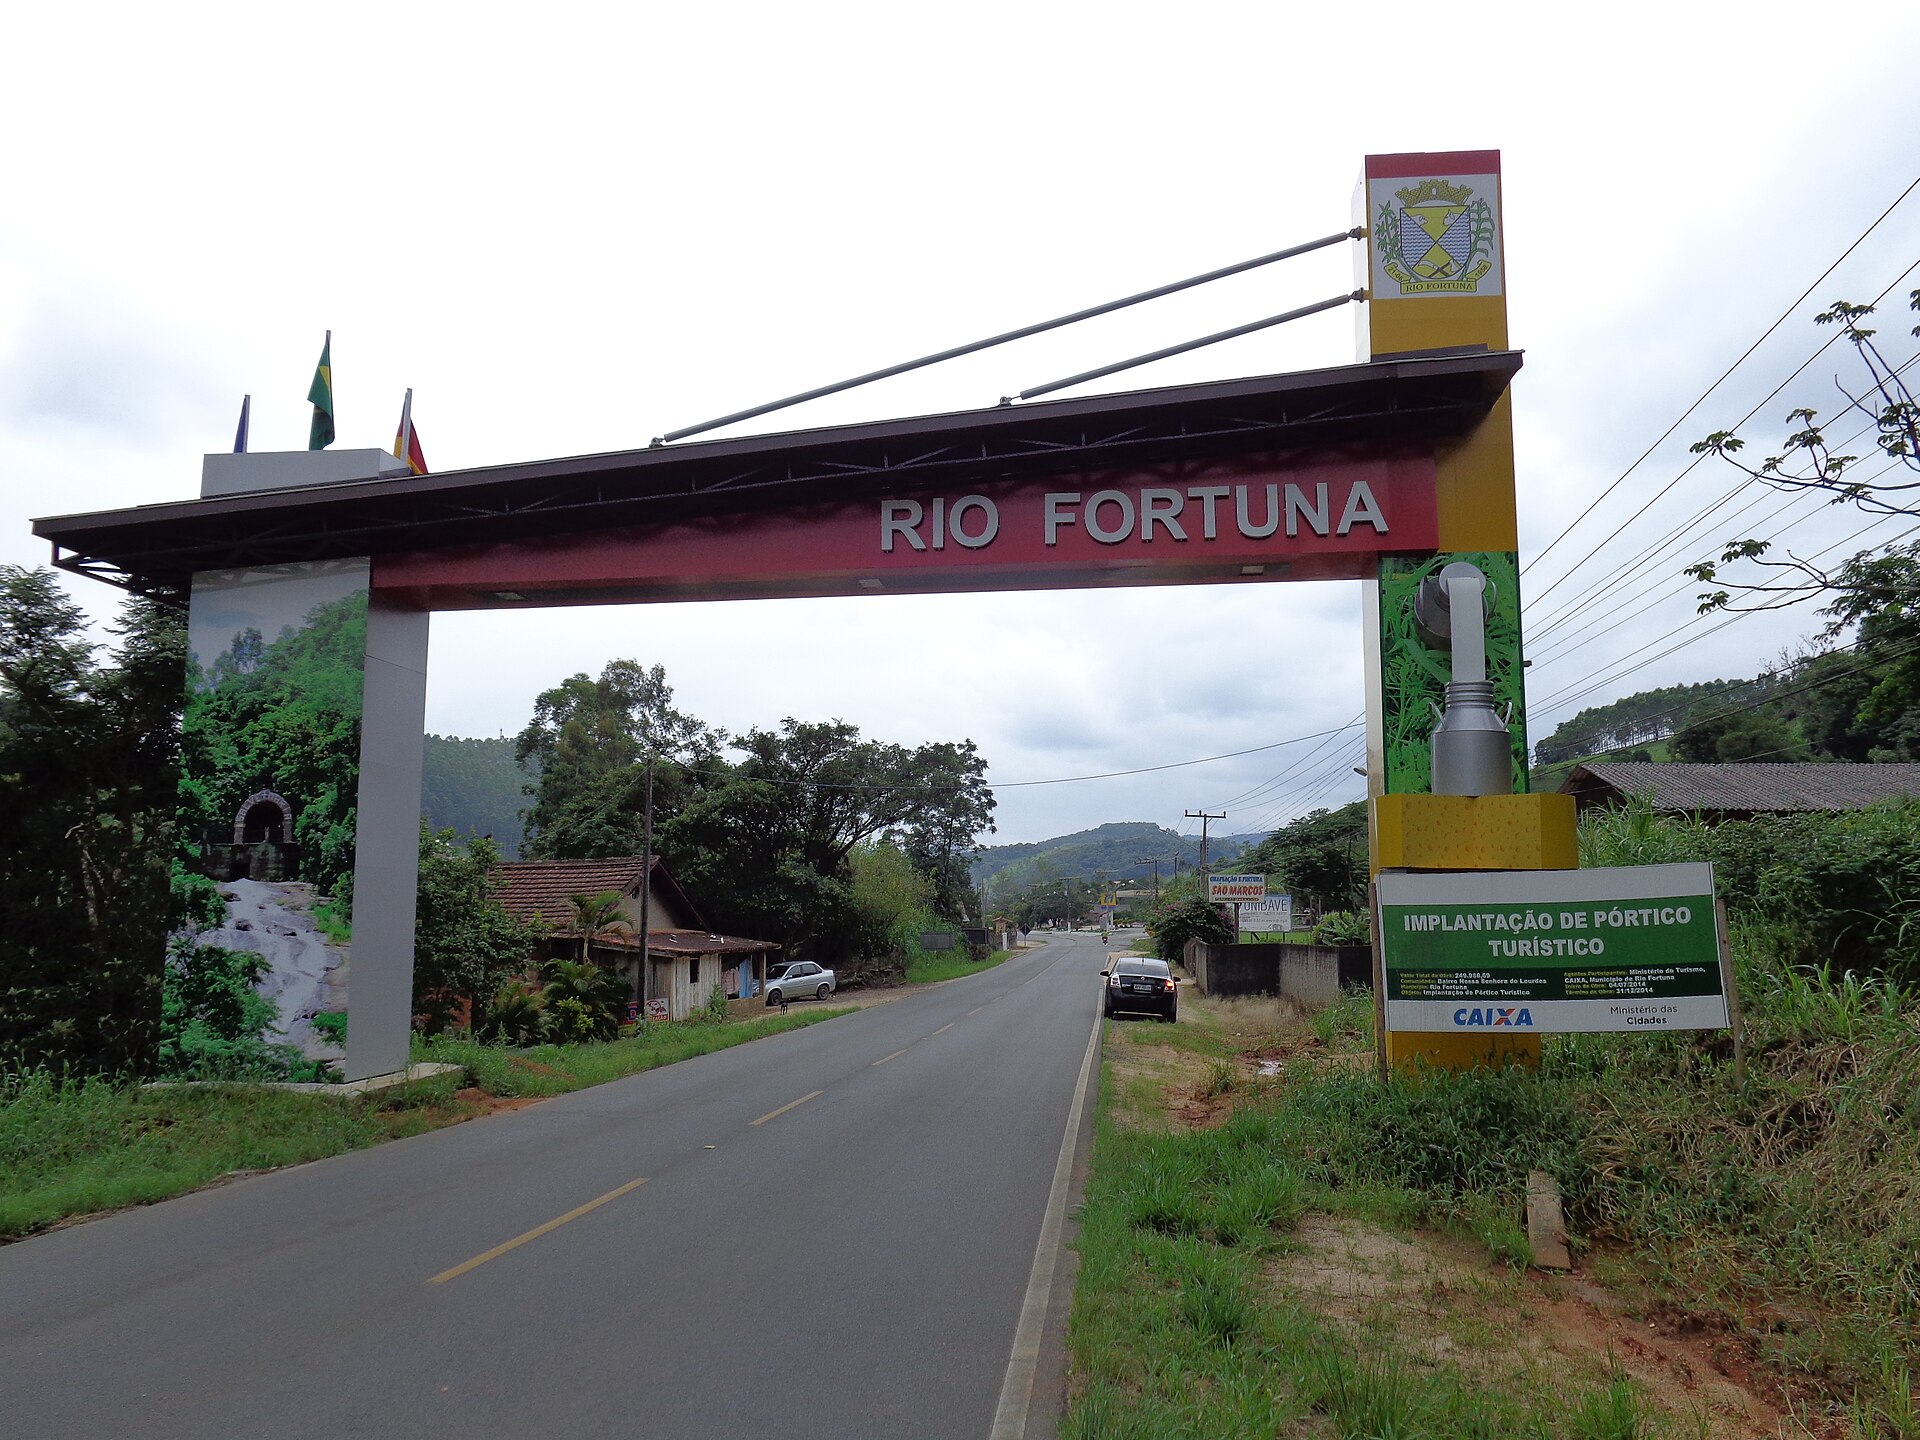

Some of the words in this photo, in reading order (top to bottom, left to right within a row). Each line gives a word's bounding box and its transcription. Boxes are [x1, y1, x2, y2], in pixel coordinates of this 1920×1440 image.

[1406, 283, 1424, 292] RIO
[1426, 282, 1473, 290] FORTUNA
[881, 494, 1000, 552] RIO
[1044, 480, 1389, 545] FORTUNA
[1229, 885, 1264, 896] MARCOS
[1244, 899, 1288, 911] UNIBAVE
[1404, 910, 1552, 934] IMPLANTAÇÃO
[1560, 912, 1588, 929] DE
[1594, 906, 1692, 927] PÓRTICO
[1488, 936, 1605, 957] TURÍSTICO
[1610, 1004, 1658, 1015] Ministério
[1660, 1004, 1678, 1014] das
[1453, 1008, 1534, 1026] CAIXA
[1626, 1015, 1668, 1026] Cidades
